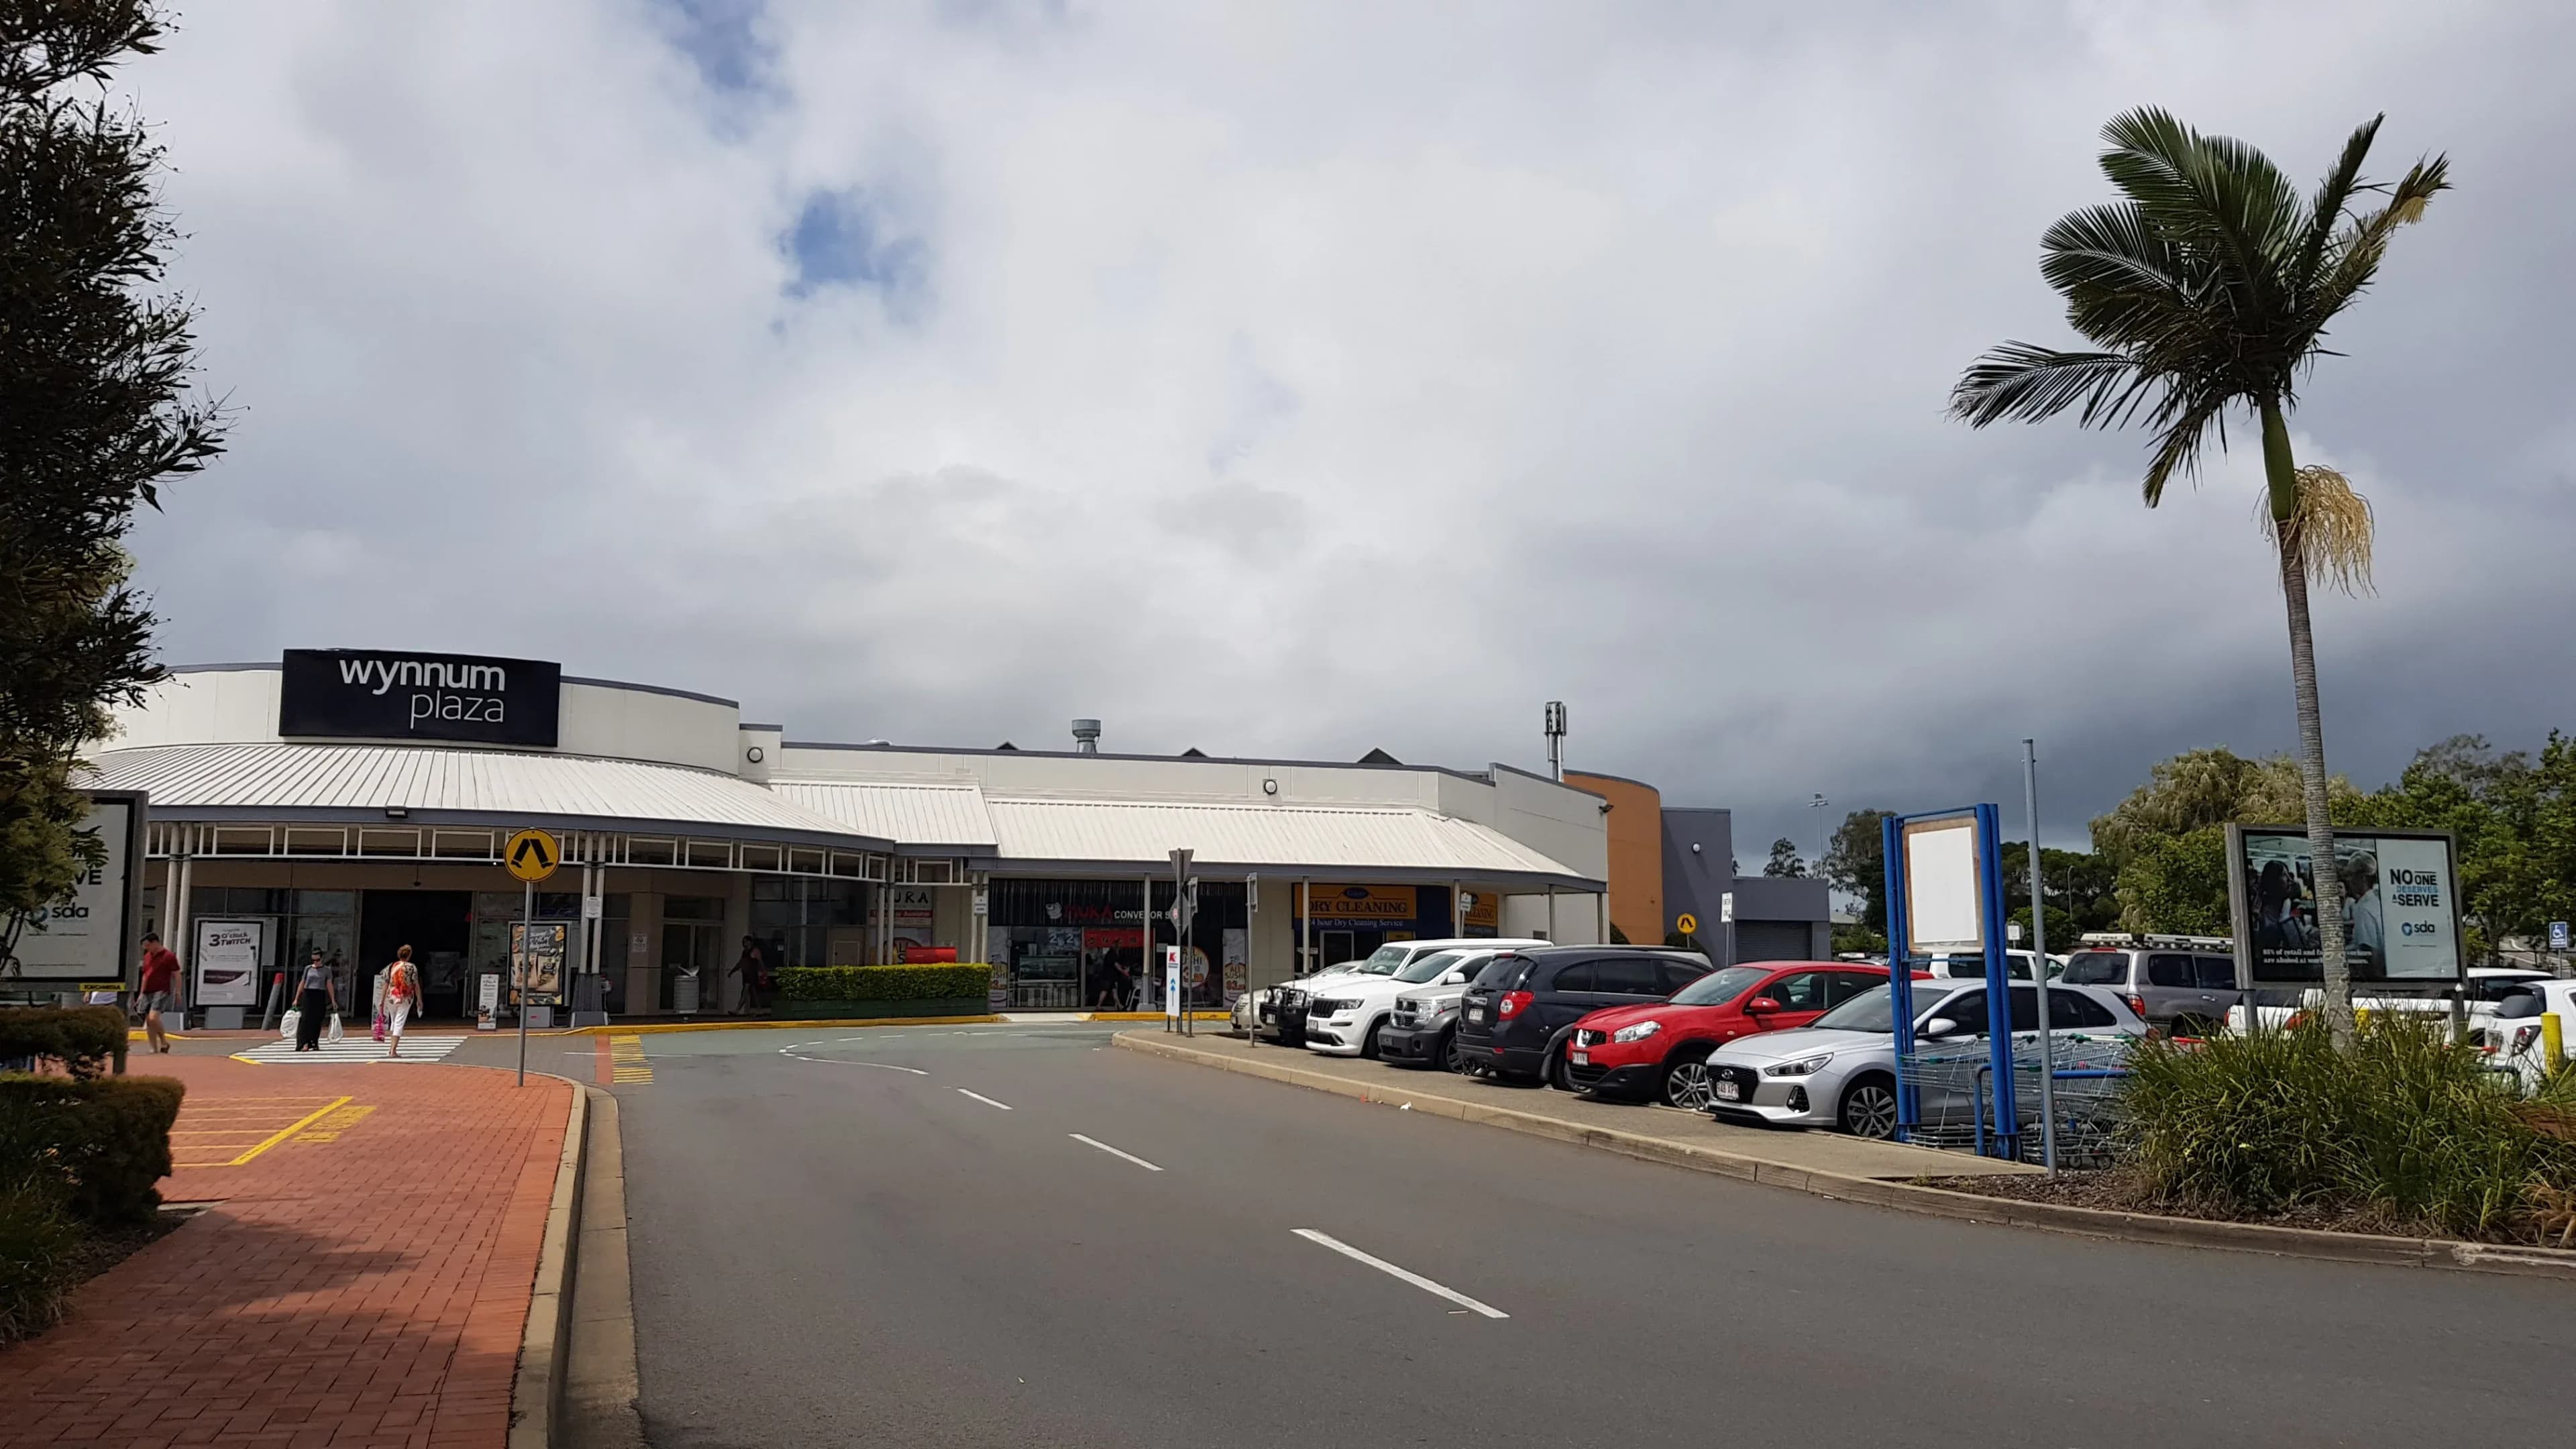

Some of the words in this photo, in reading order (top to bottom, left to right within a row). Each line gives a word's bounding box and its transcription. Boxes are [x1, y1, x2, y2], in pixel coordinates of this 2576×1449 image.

[339, 659, 505, 696] wynnum
[410, 690, 504, 730] plaza
[2390, 869, 2413, 885] NO
[2414, 875, 2438, 885] ONE
[2396, 885, 2438, 894] DESERVES
[1336, 901, 1407, 913] CLEANING
[2398, 894, 2440, 907] SERVE
[52, 902, 89, 918] sda
[1114, 910, 1163, 920] CONVEOR
[1316, 918, 1333, 926] hour
[1334, 919, 1347, 928] Dry
[1348, 920, 1378, 928] Cleaning
[2414, 920, 2435, 933] sda
[209, 934, 220, 947] 3
[221, 938, 251, 946] TWITCH
